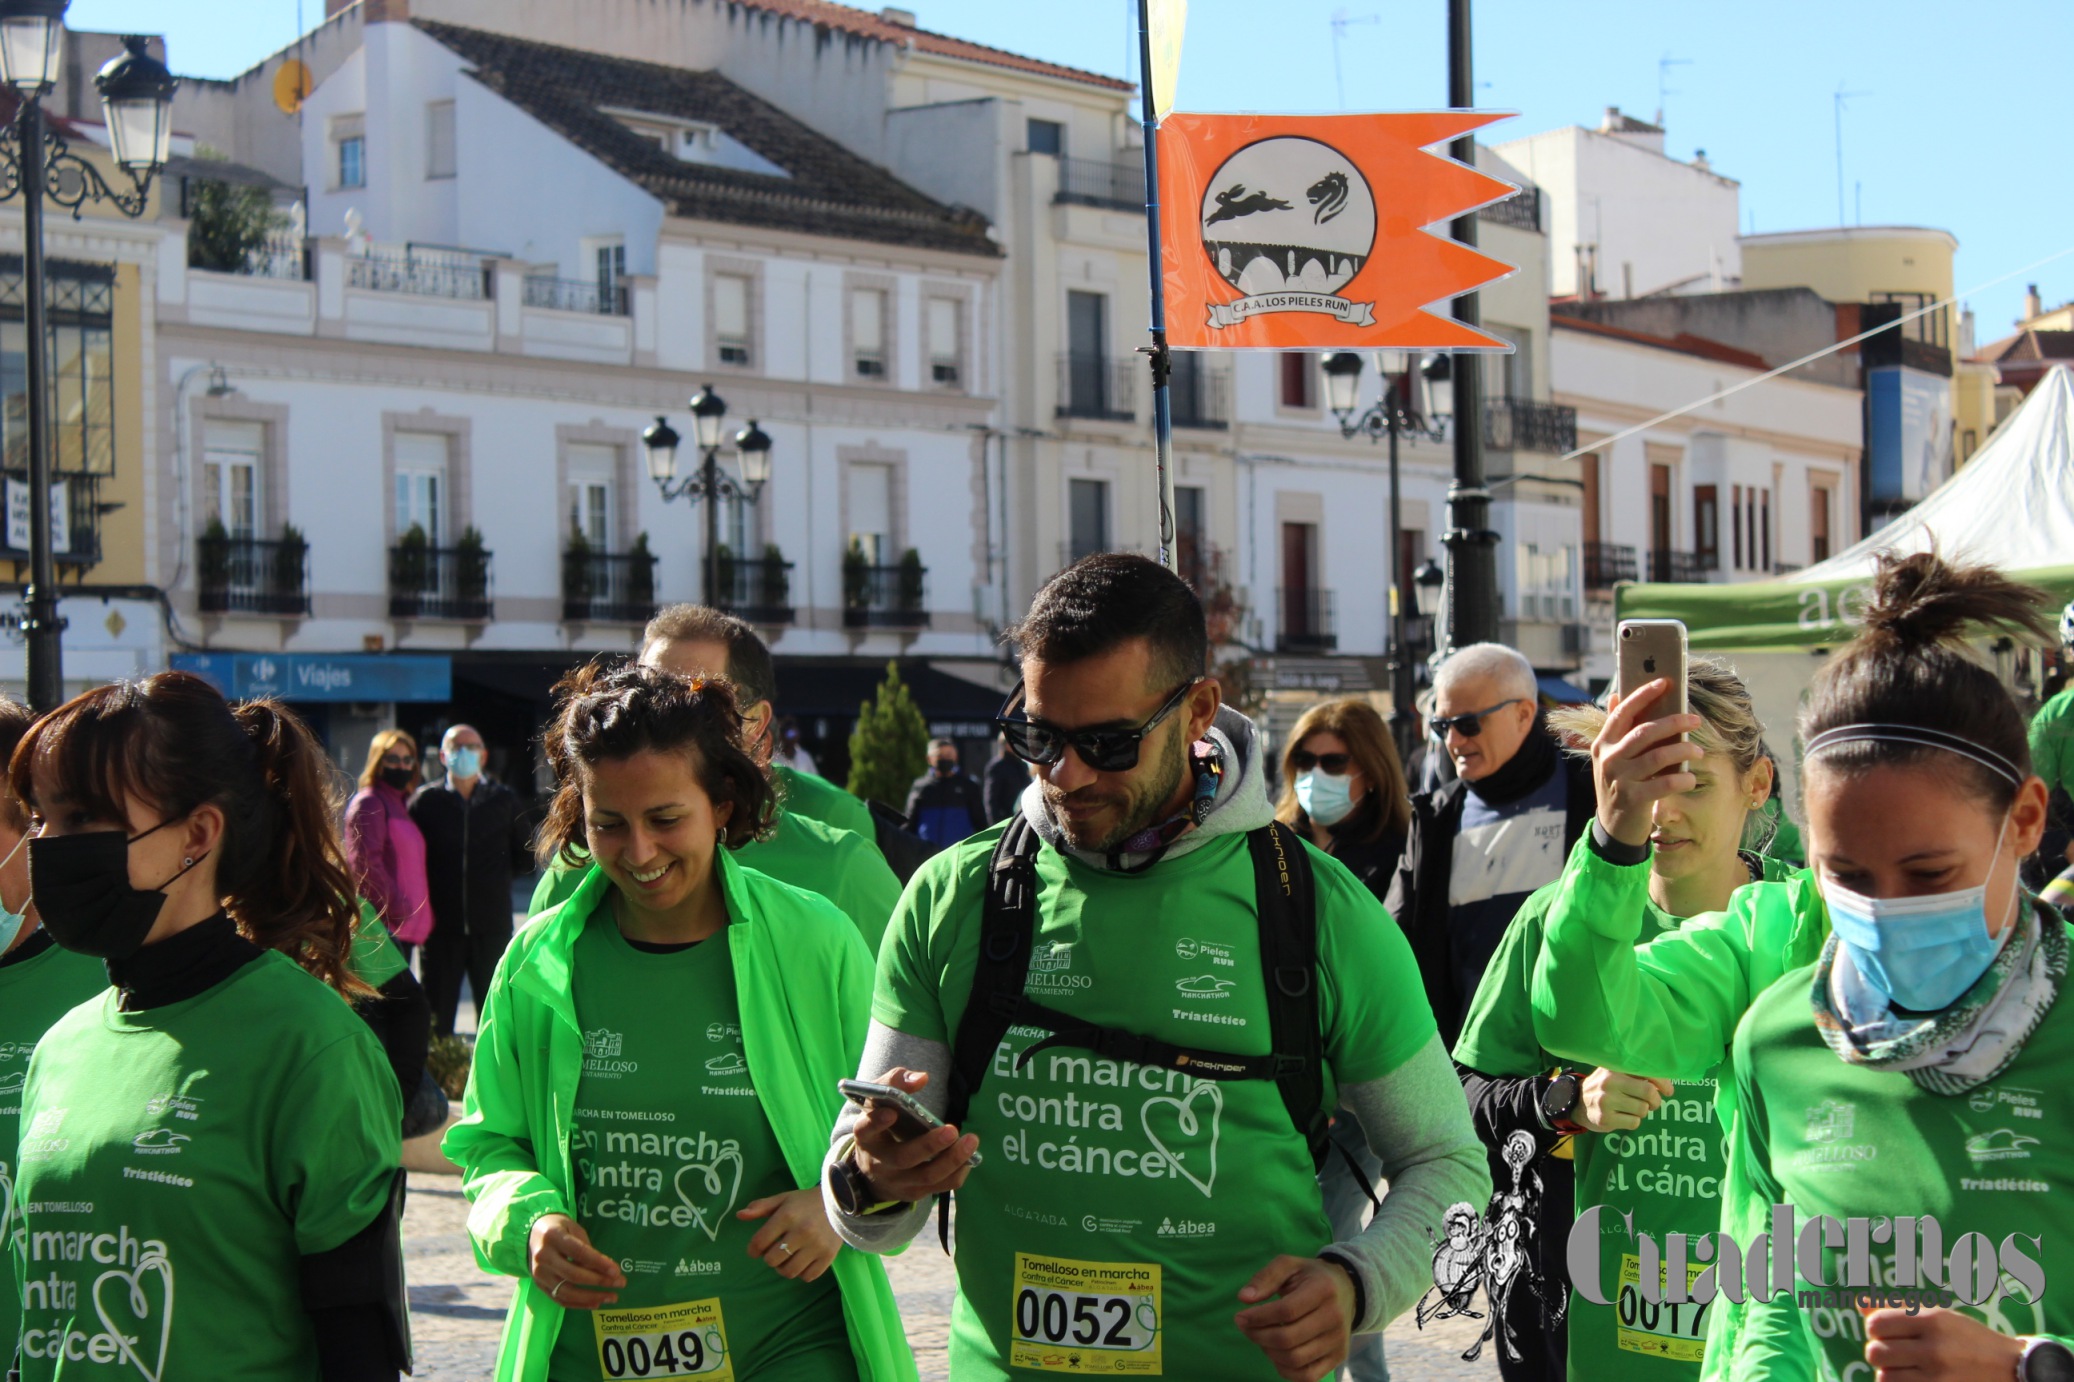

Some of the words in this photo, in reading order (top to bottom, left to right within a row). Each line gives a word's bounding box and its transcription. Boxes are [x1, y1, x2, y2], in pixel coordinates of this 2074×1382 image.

[1233, 301, 1264, 313] C.A.A.
[1266, 296, 1286, 307] LOS
[1288, 297, 1323, 307] PIELES
[1325, 299, 1348, 312] RUN
[298, 663, 351, 691] Viajes
[1200, 945, 1230, 957] Pieles
[1213, 957, 1234, 966] RUN
[1025, 973, 1092, 988] MELLOSO
[1172, 1009, 1246, 1026] Triatlético
[582, 1059, 637, 1073] MELLOSO
[1671, 1078, 1718, 1087] MELLOSO
[168, 1100, 197, 1111] Pieles
[1998, 1092, 2037, 1106] Pieles
[601, 1110, 613, 1119] EN
[615, 1111, 675, 1121] TOMELLOSO
[998, 1092, 1123, 1131] contra
[1647, 1099, 1716, 1124] mar
[2013, 1106, 2043, 1119] RUN
[570, 1123, 598, 1152] En
[606, 1131, 740, 1160] marcha
[1604, 1128, 1706, 1162] contra
[1002, 1128, 1030, 1165] el
[1037, 1135, 1185, 1178] cáncer
[123, 1167, 193, 1188] Triatlético
[1606, 1163, 1629, 1191] el
[1960, 1178, 2050, 1192] Triatlético
[28, 1202, 43, 1214] EN
[44, 1202, 94, 1214] TOMELLOSO
[597, 1193, 708, 1228] cáncer
[1178, 1220, 1216, 1234] ábea
[32, 1225, 168, 1270] marcha
[690, 1260, 721, 1272] ábea
[1022, 1257, 1079, 1276] Tomelloso
[1081, 1268, 1097, 1278] en
[1100, 1268, 1149, 1280] marcha
[1022, 1271, 1046, 1282] Contra
[1047, 1274, 1054, 1284] el
[1055, 1276, 1084, 1287] Cáncer
[24, 1271, 77, 1310] ntra
[599, 1313, 652, 1323] Tomelloso
[653, 1311, 668, 1320] en
[670, 1304, 712, 1318] marcha
[1016, 1289, 1131, 1346] 0052
[1619, 1284, 1709, 1336] 0017
[601, 1324, 624, 1332] Contra
[625, 1323, 632, 1331] el
[23, 1319, 139, 1365] cácer
[602, 1331, 704, 1378] 0049
